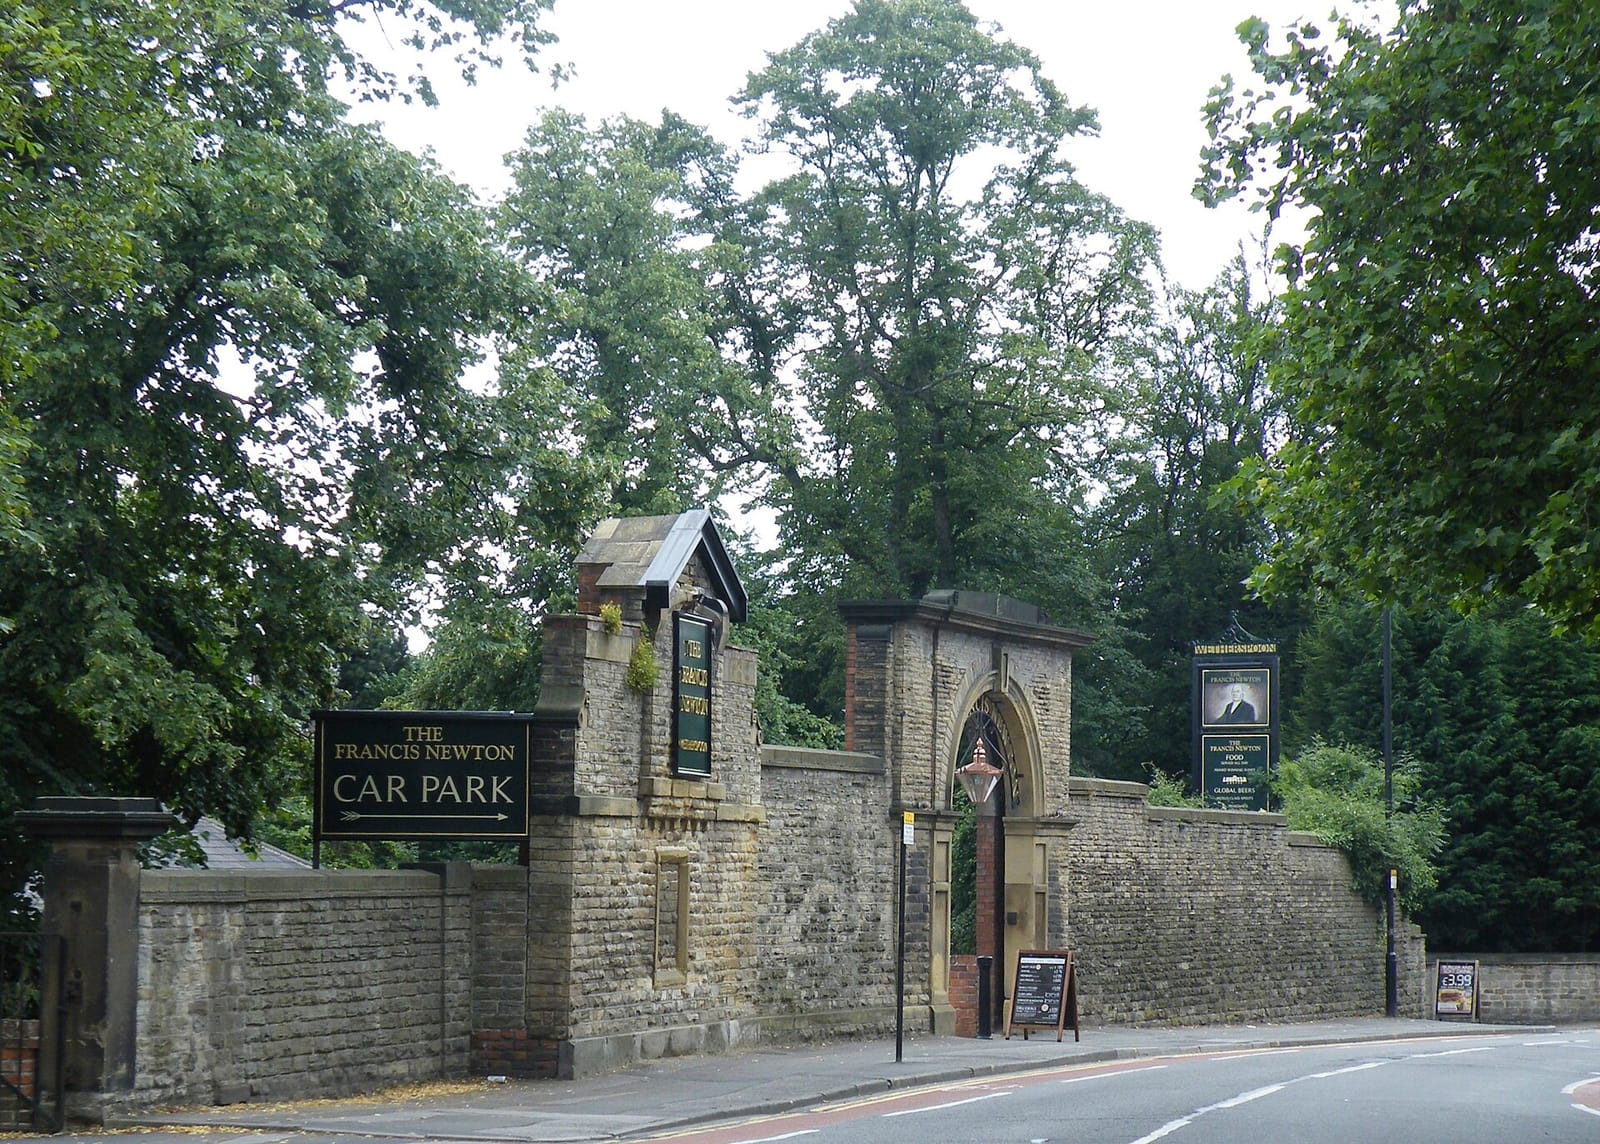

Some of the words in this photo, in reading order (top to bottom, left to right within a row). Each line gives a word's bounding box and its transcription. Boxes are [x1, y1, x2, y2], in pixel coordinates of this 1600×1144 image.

[684, 639, 702, 658] THE
[1194, 643, 1277, 654] WETHERSPOON
[402, 726, 443, 742] THE
[334, 744, 420, 760] FRANCIS
[425, 744, 516, 761] NEWTON
[333, 774, 408, 803] CAR
[421, 775, 514, 803] PARK
[1442, 974, 1472, 986] £3.99
